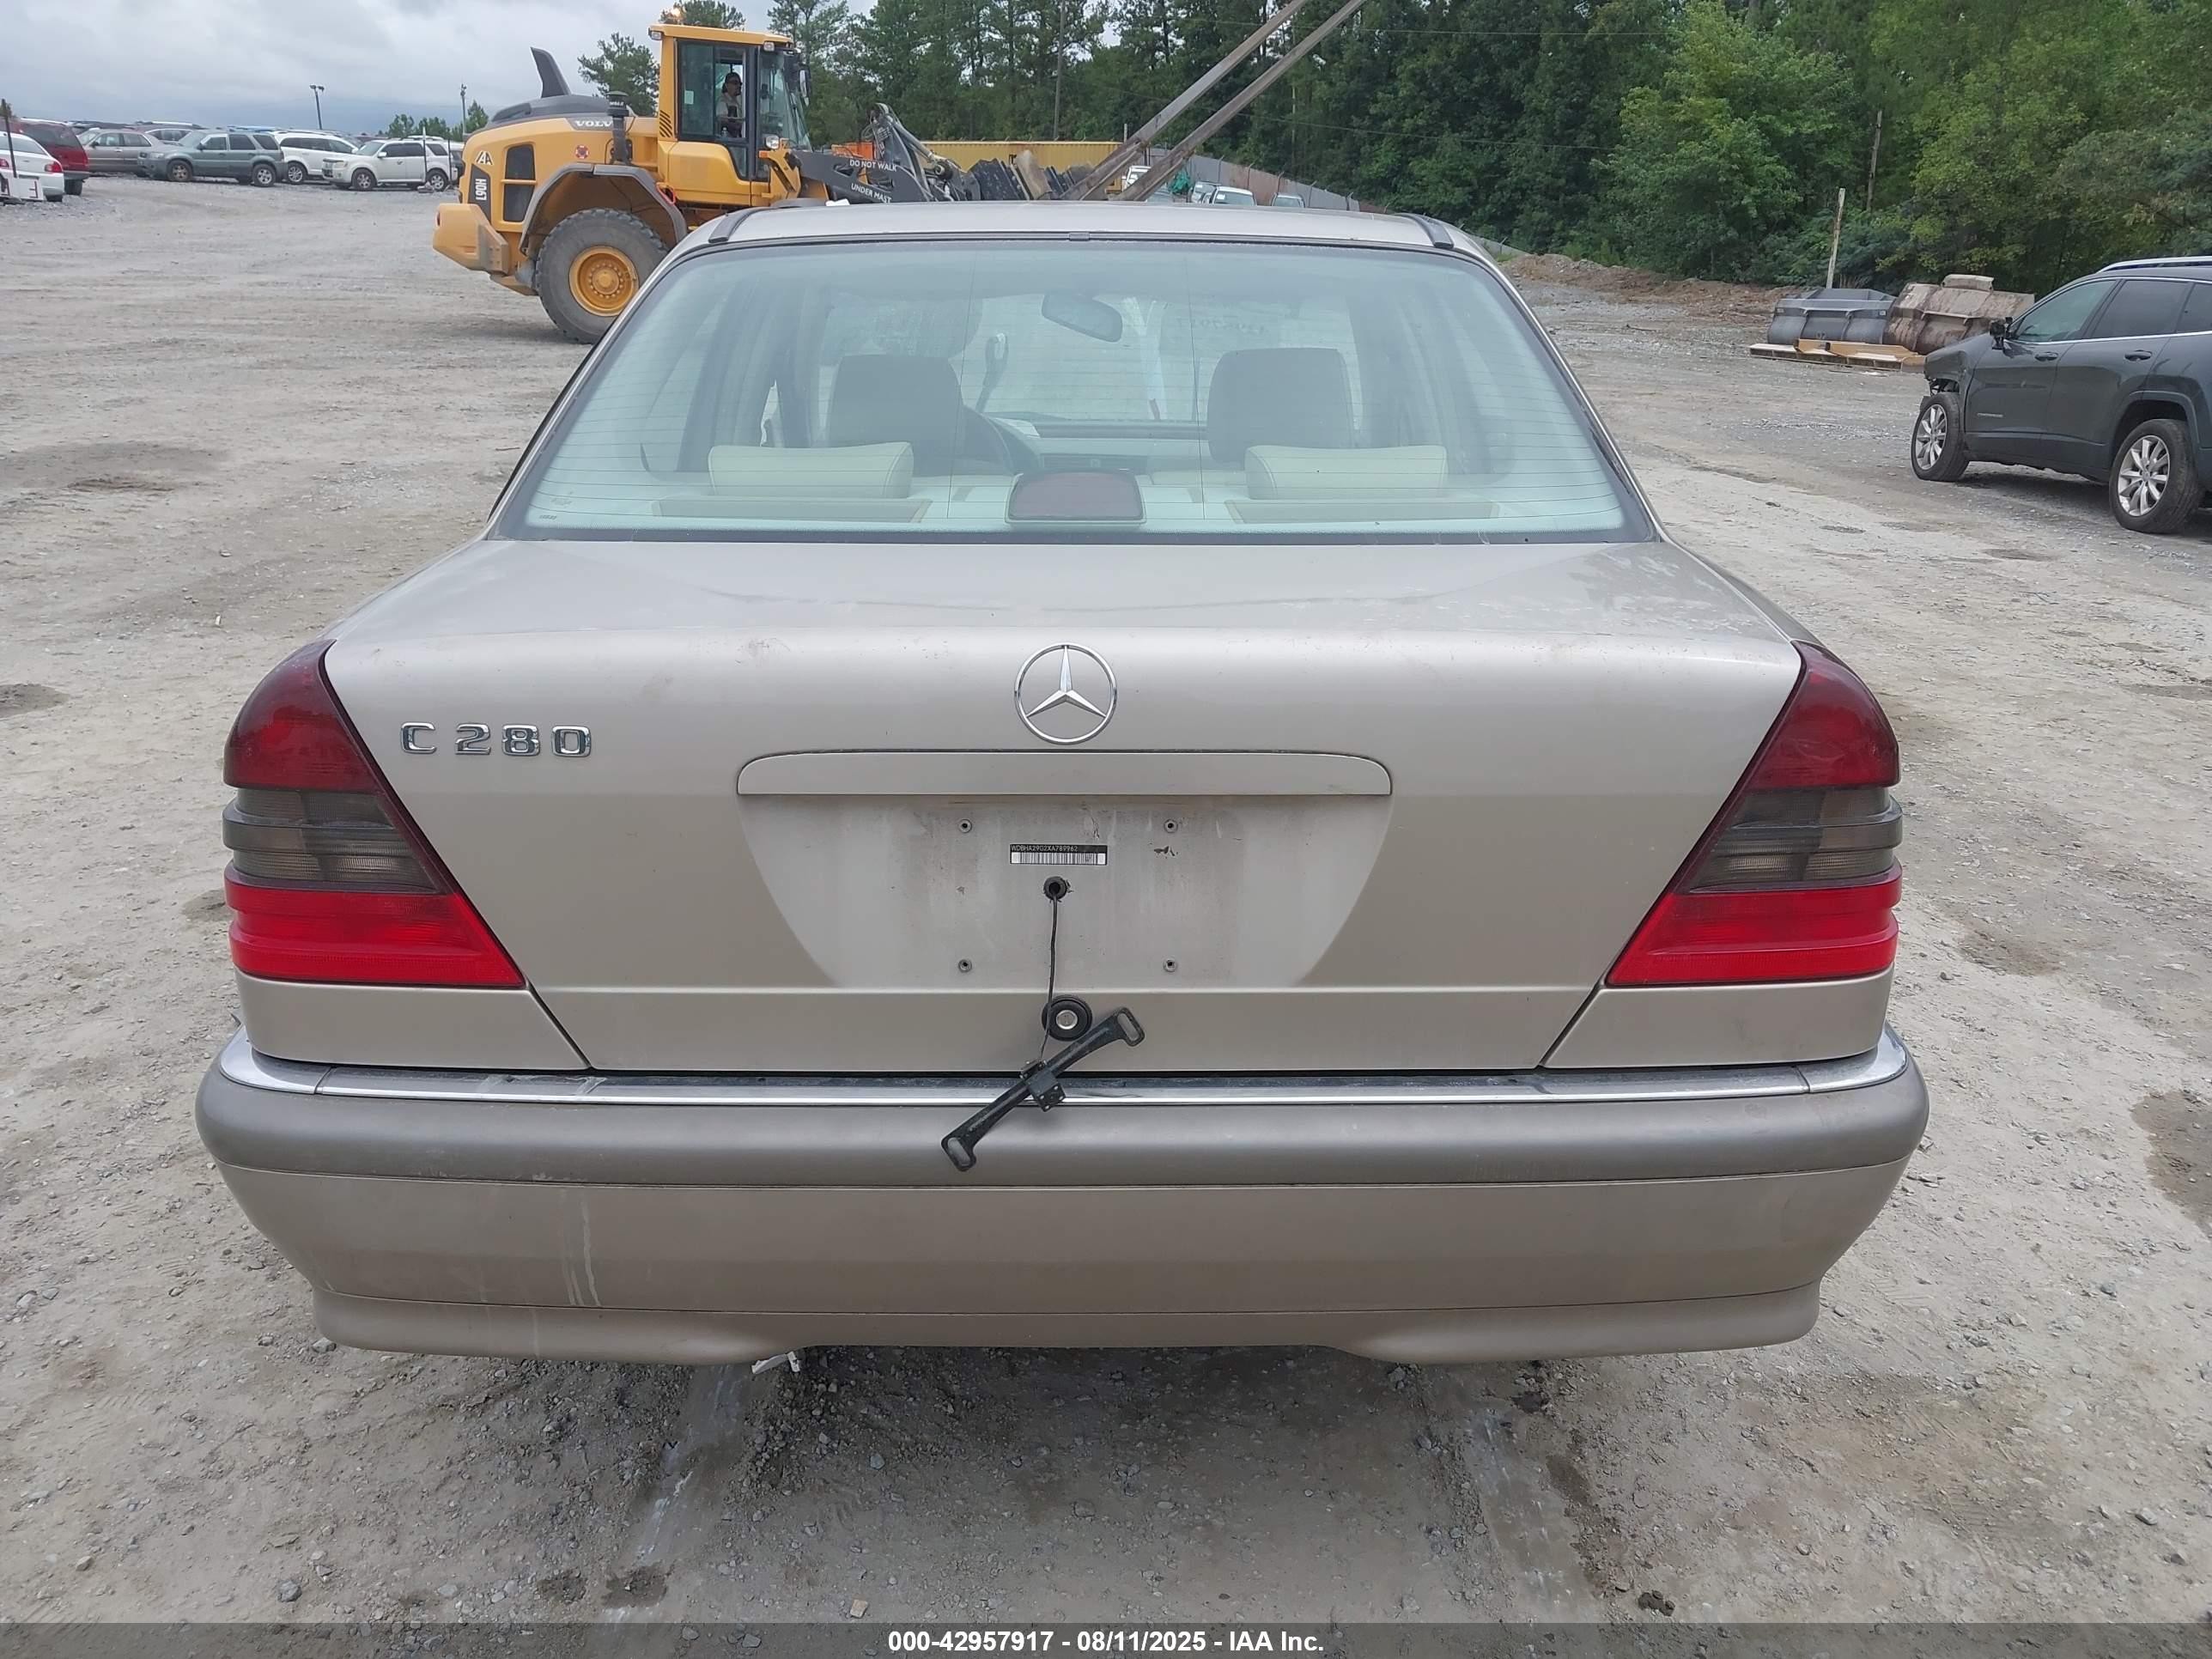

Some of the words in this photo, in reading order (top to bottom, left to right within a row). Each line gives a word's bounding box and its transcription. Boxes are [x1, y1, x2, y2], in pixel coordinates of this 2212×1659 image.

[861, 161, 876, 169] NOT
[878, 161, 897, 172] WALK
[475, 178, 488, 201] L90H
[851, 183, 872, 198] UNDER
[874, 191, 892, 204] MAST
[401, 721, 437, 754] C
[455, 722, 592, 757] 280
